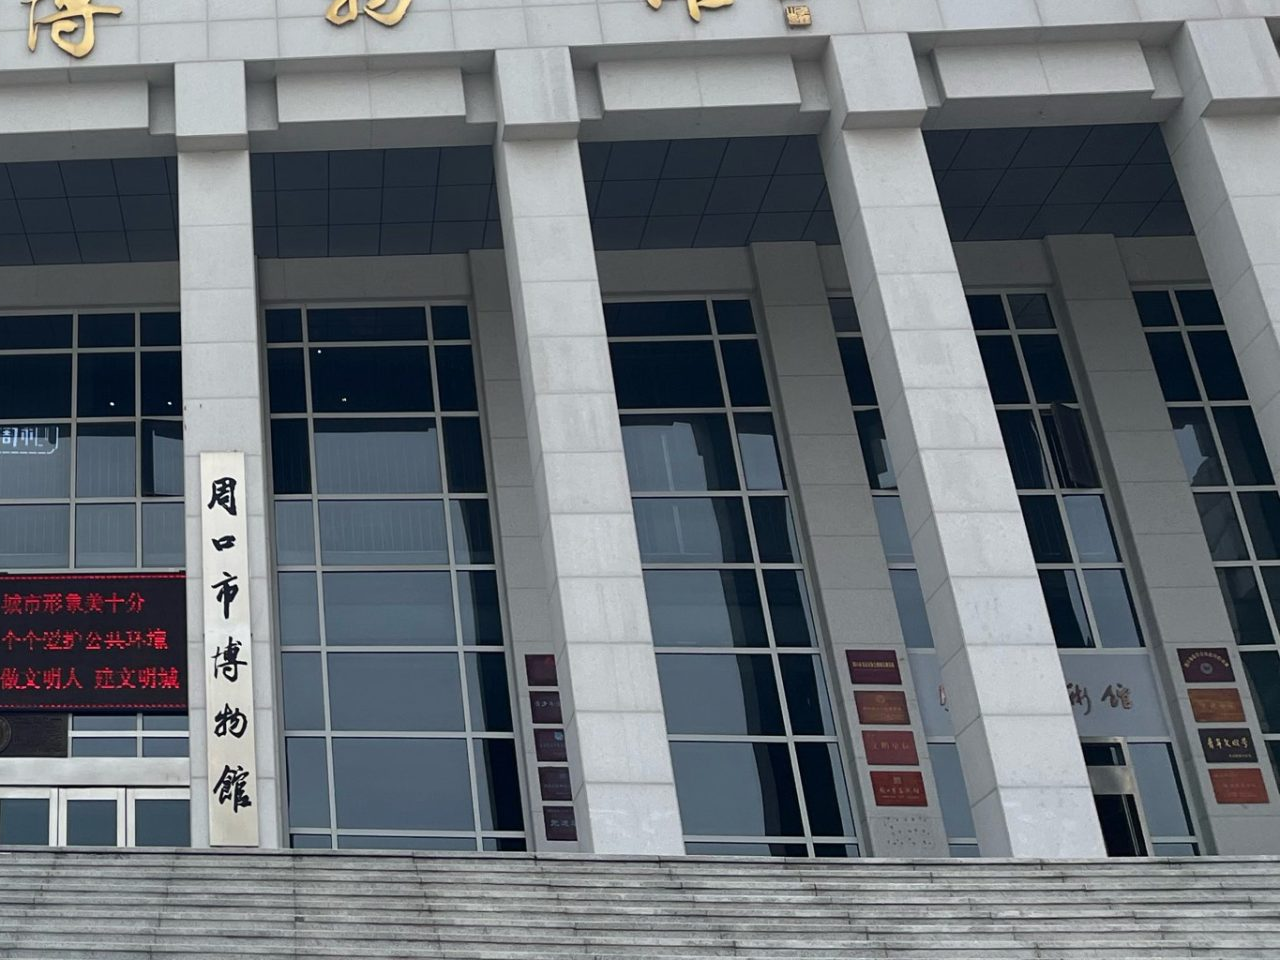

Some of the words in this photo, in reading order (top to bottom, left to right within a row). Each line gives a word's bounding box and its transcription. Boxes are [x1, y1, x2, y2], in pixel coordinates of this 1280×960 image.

[1, 591, 146, 616] 城市形象美十分
[0, 666, 84, 691] 做文明人
[94, 666, 181, 691] 建文明城
